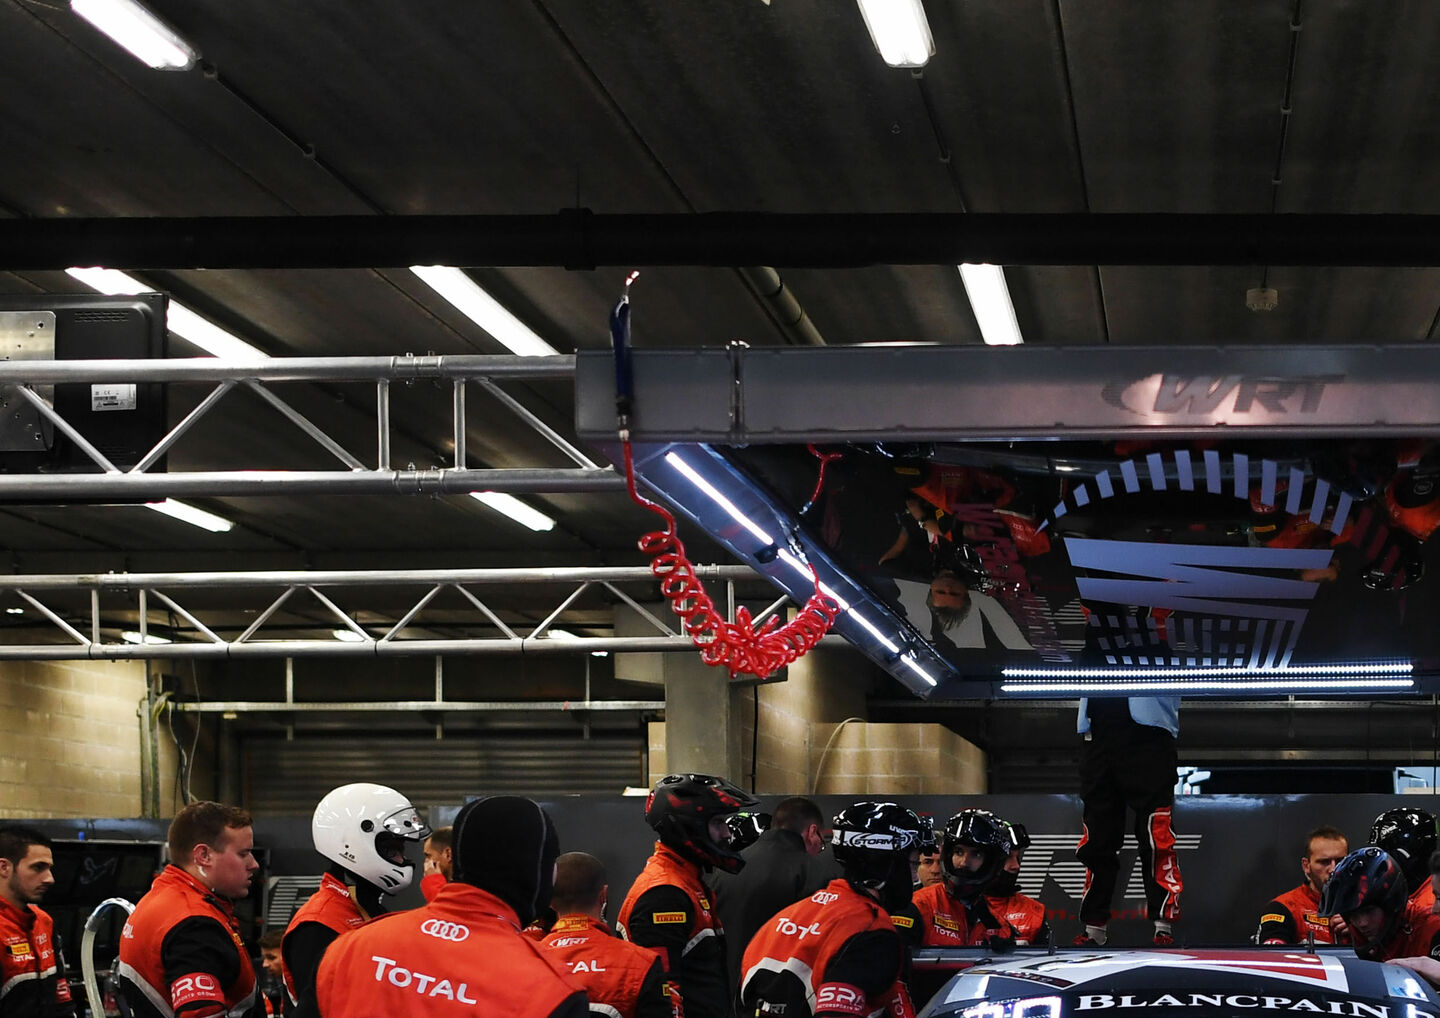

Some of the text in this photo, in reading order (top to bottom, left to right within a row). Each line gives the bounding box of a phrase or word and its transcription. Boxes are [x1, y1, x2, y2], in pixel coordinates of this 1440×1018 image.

[1152, 373, 1347, 414] WRT
[556, 937, 589, 948] WRT
[371, 955, 477, 1006] TOTAL
